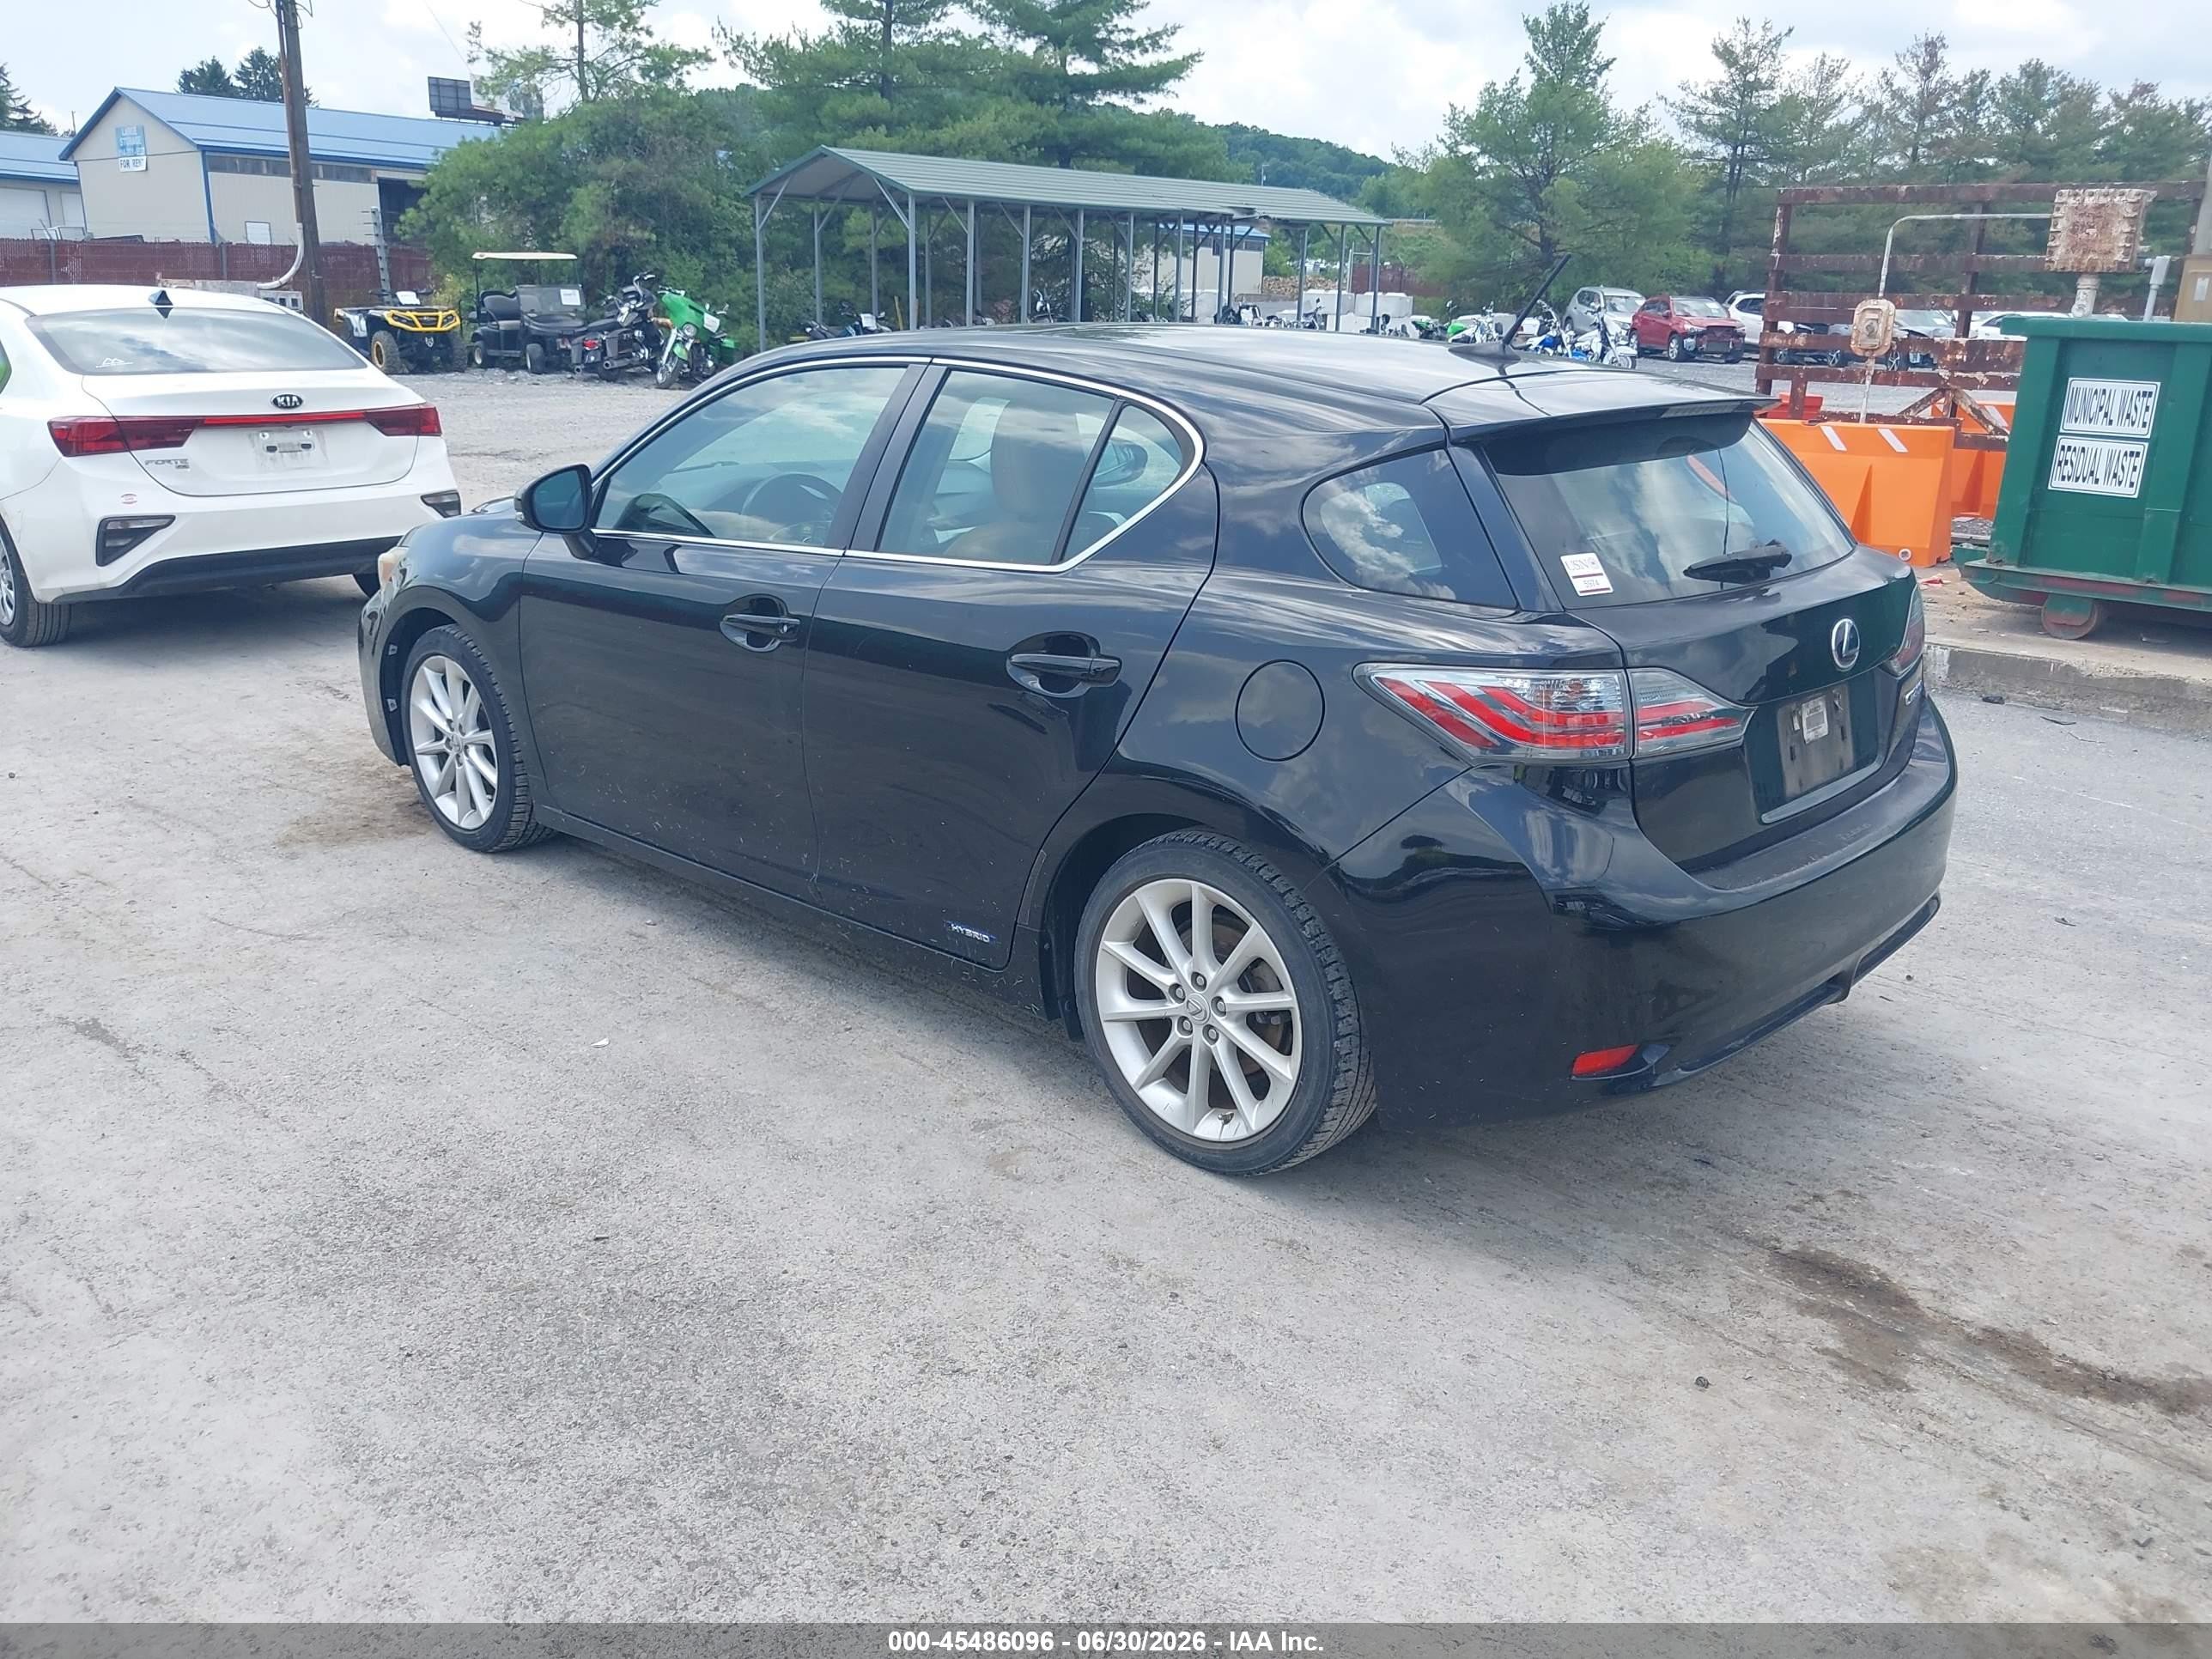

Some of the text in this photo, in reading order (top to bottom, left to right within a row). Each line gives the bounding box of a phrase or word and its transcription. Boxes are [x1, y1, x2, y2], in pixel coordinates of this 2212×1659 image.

[119, 159, 130, 169] FOR
[276, 396, 301, 406] KIA
[2066, 386, 2154, 428] MUNICIPAL WASTE
[2053, 445, 2141, 489] RESIDUAL WASTE
[951, 923, 990, 943] HYBRID
